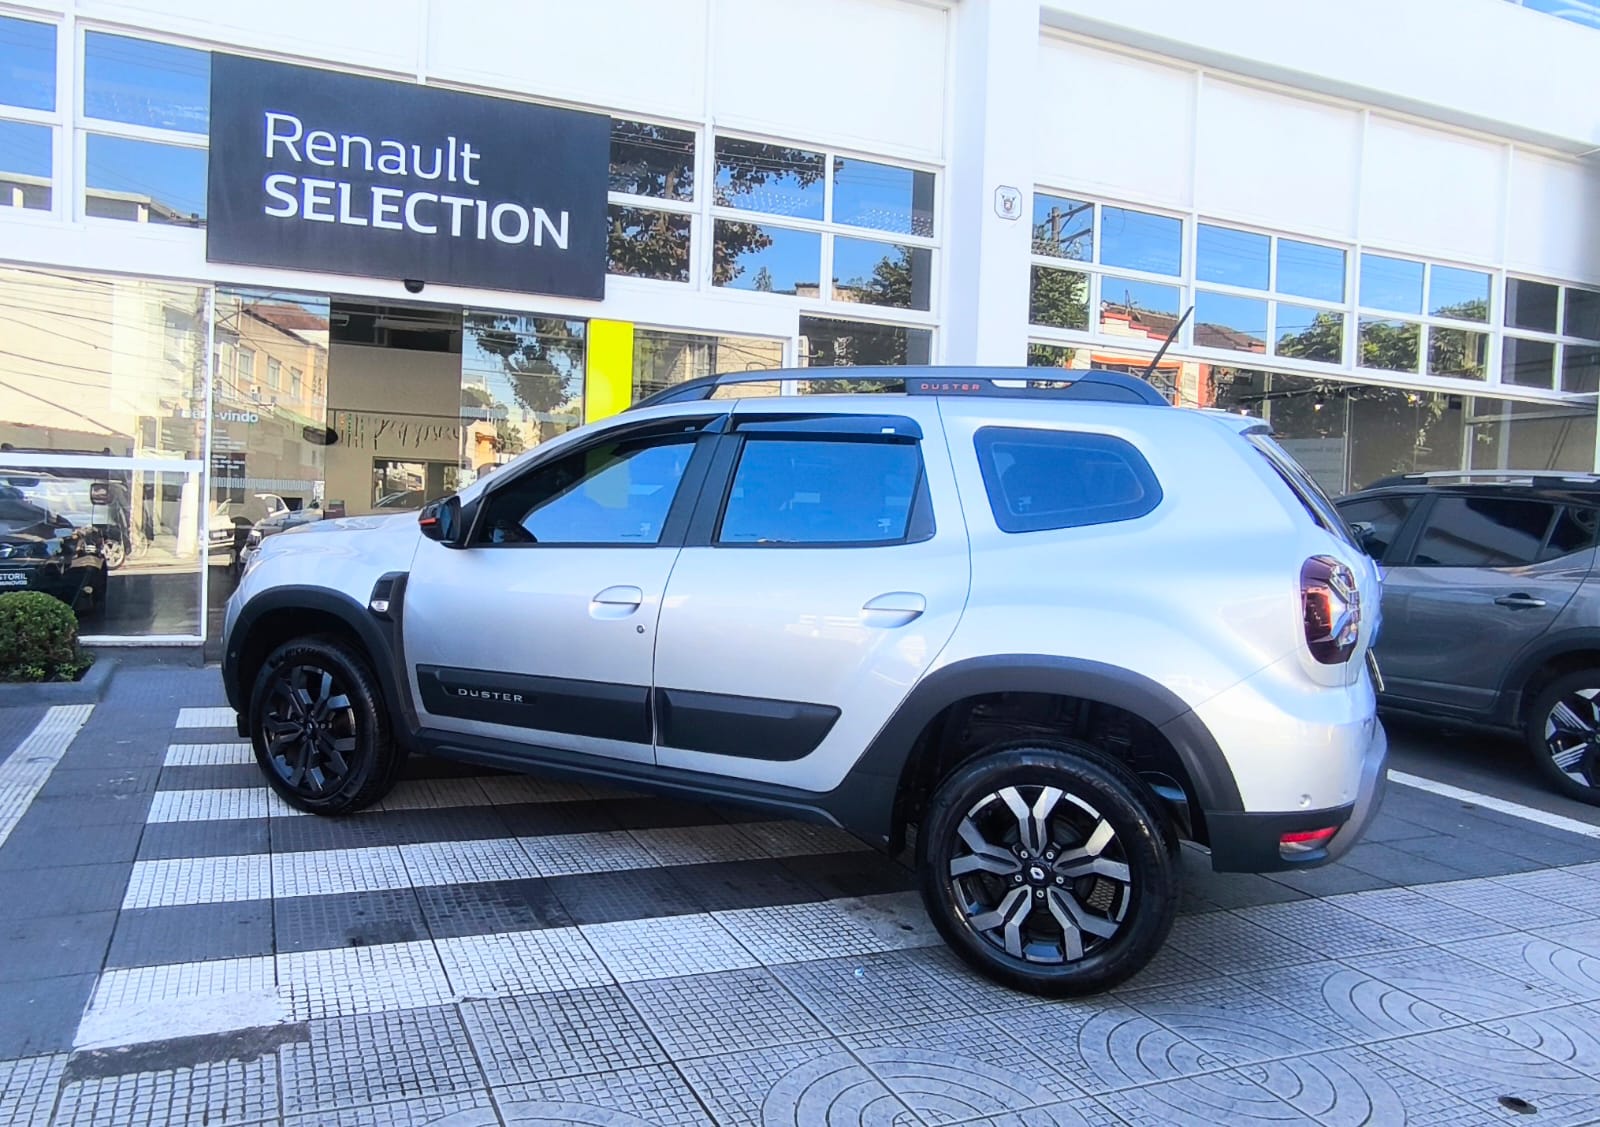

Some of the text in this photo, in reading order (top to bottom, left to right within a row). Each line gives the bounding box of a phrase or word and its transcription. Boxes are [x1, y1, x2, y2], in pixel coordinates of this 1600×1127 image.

[264, 111, 481, 186] Renault
[263, 173, 570, 250] SELECTION
[921, 383, 981, 392] DUSTER
[457, 688, 523, 703] DUSTER
